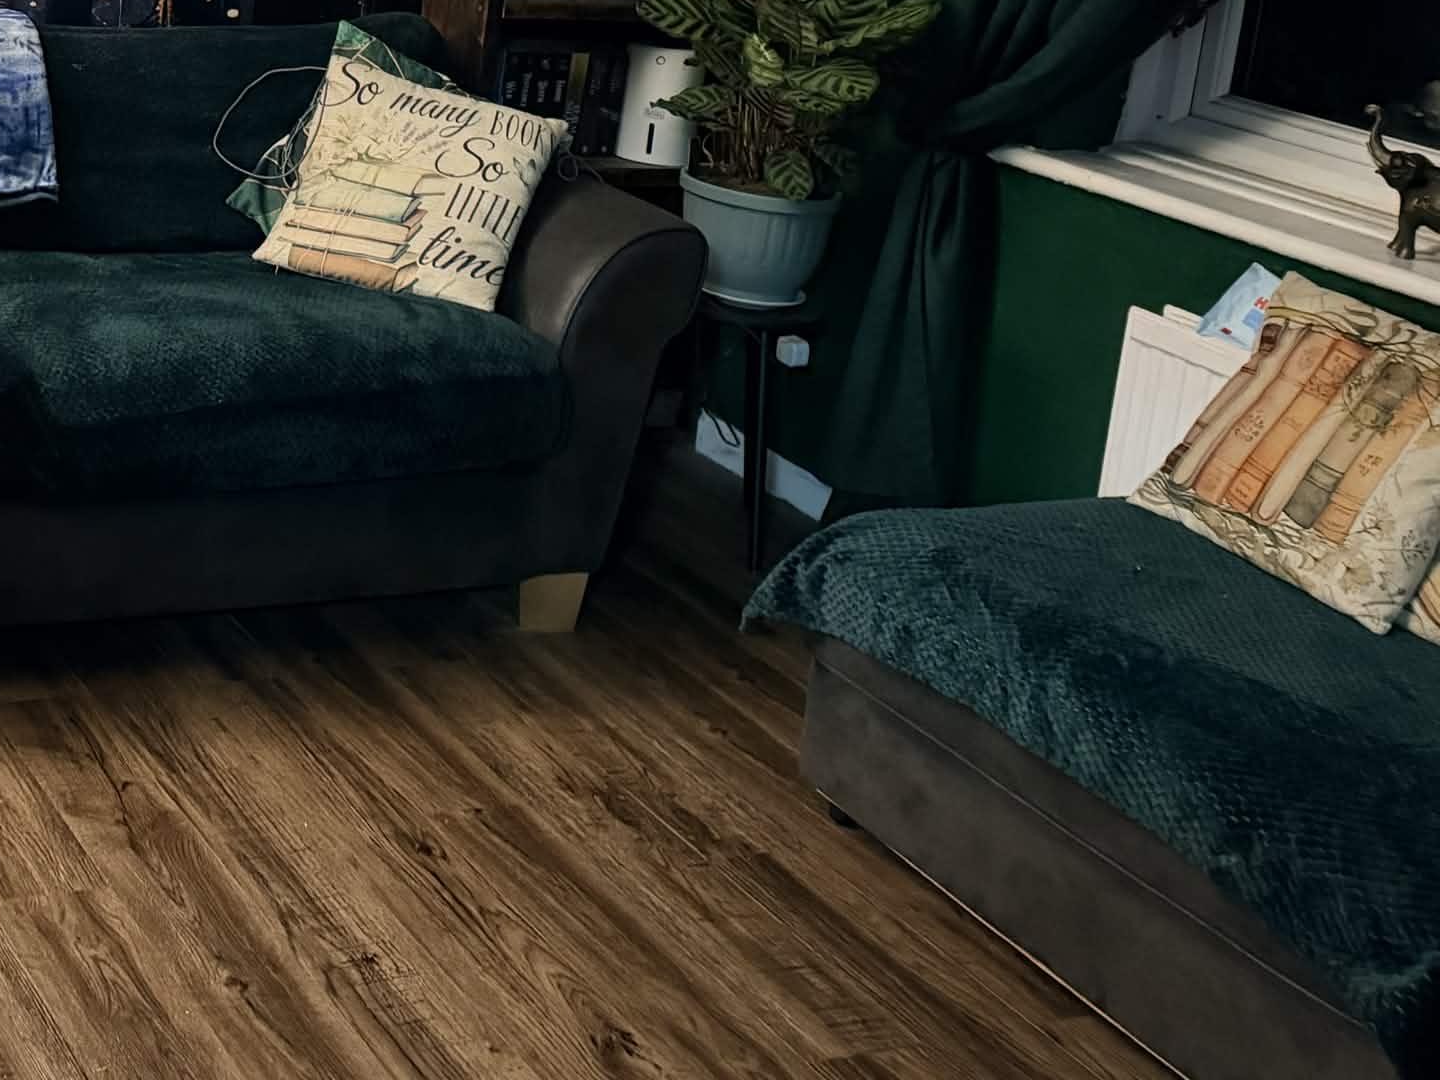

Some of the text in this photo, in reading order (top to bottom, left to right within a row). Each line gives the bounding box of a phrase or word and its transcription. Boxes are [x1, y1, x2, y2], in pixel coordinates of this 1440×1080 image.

[318, 60, 558, 156] So many BOOK
[434, 136, 510, 185] So
[417, 223, 505, 286] time
